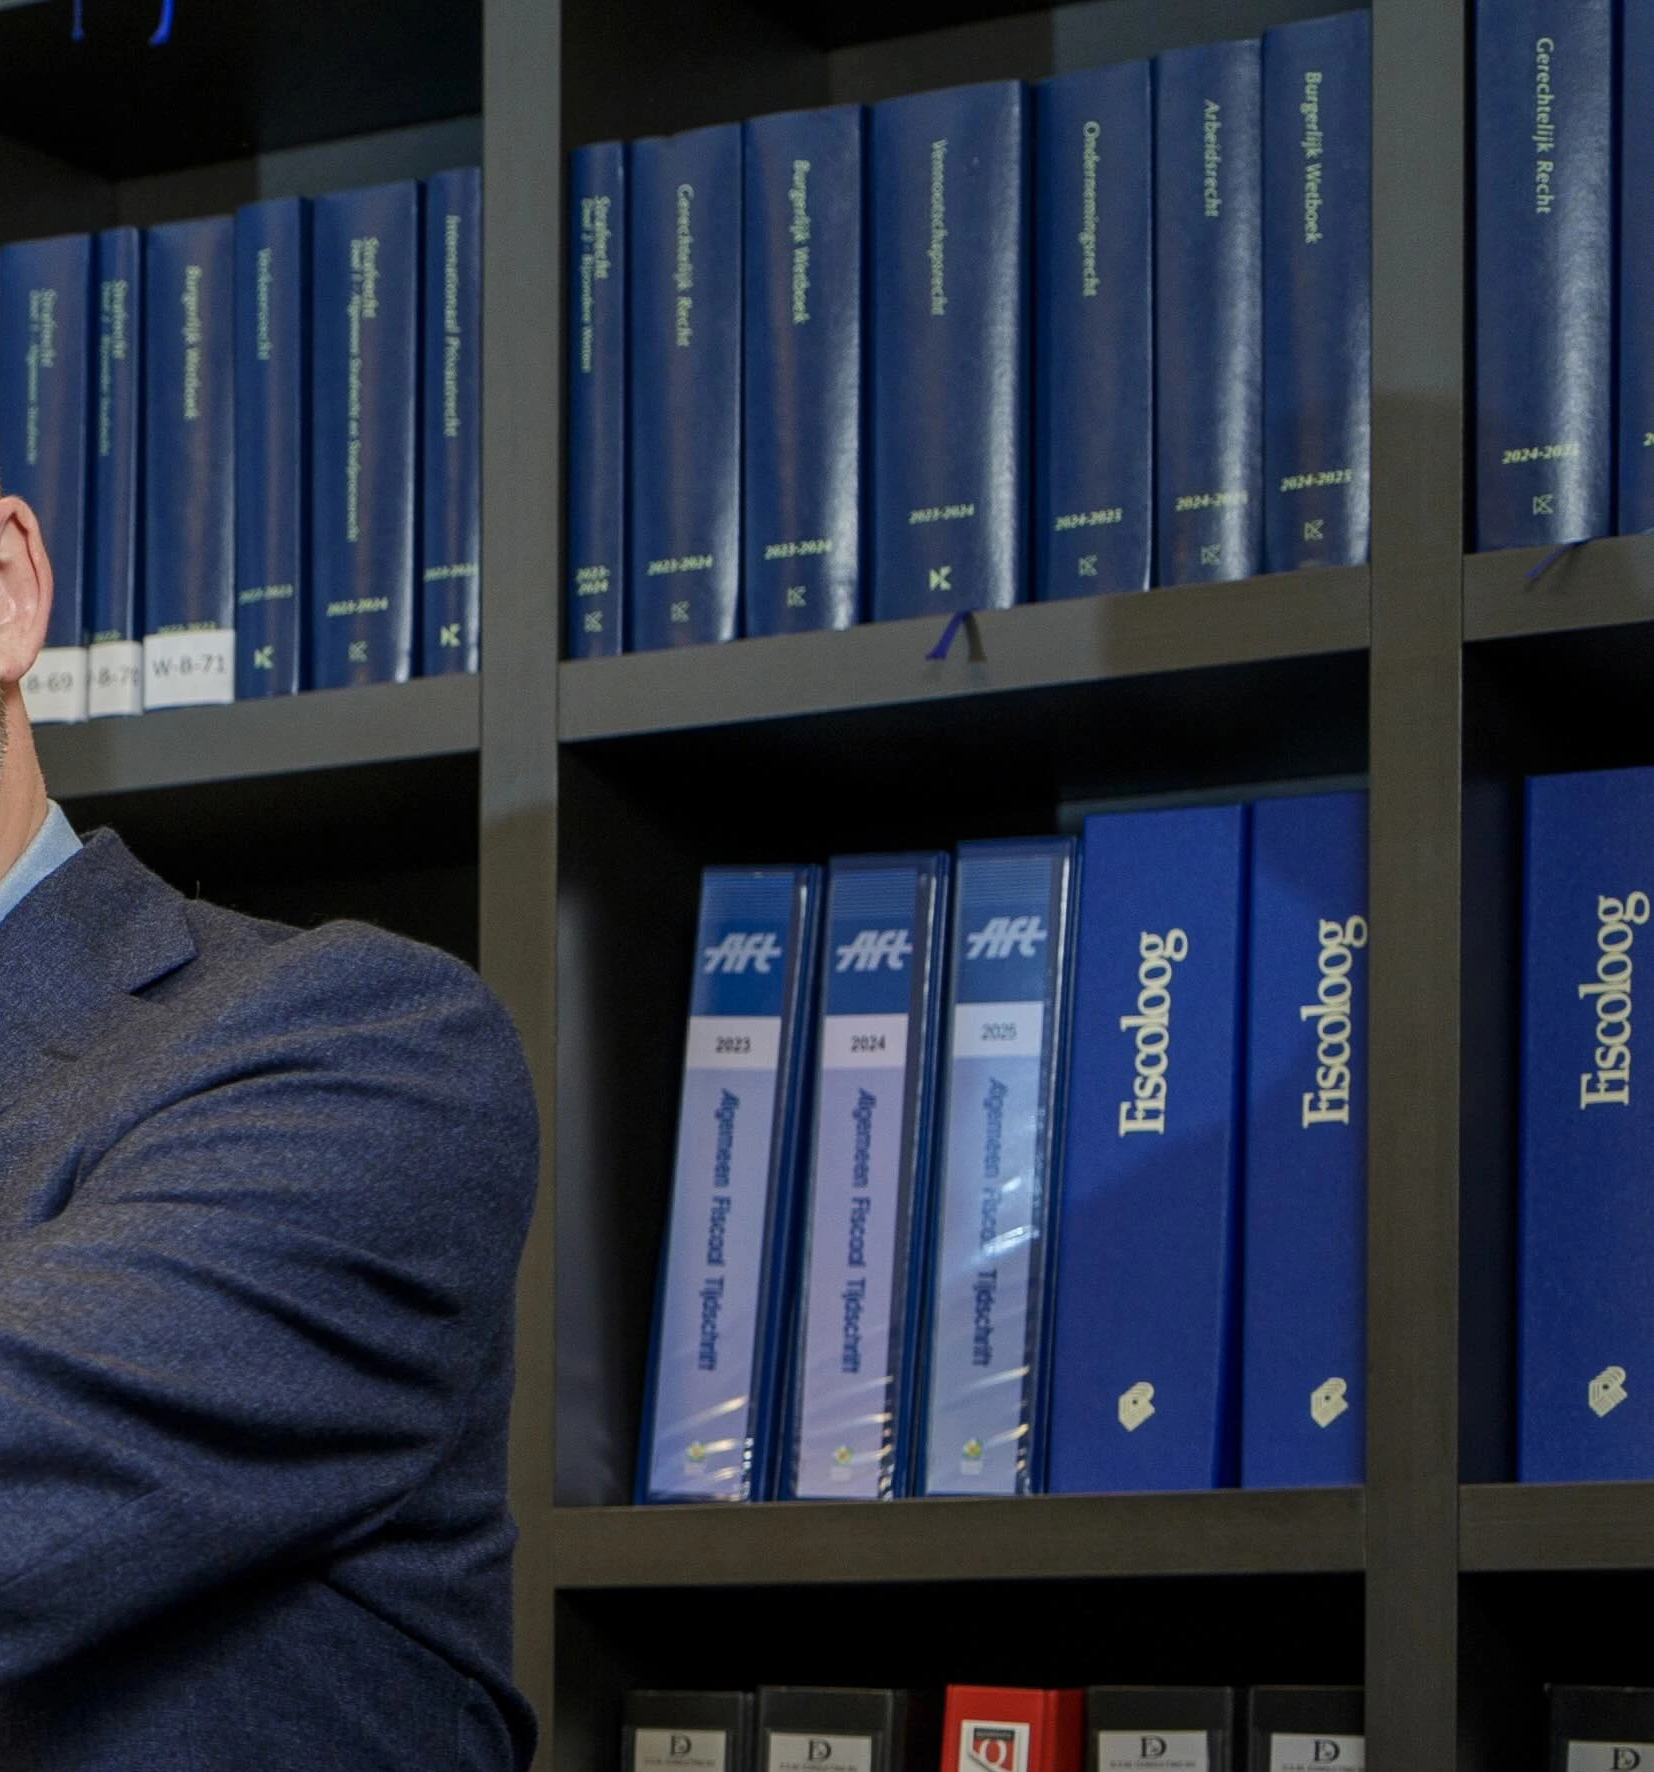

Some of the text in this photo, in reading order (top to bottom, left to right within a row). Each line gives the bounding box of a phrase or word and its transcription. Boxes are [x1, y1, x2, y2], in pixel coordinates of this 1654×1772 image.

[1077, 119, 1101, 297] Ondernemingsrecht
[1202, 98, 1221, 218] Arbeidsrecht
[1300, 70, 1323, 244] Burgerlijk Wetboek
[1532, 37, 1554, 214] Gerechtelijk Recht
[151, 653, 227, 679] W-B-71
[714, 1035, 752, 1054] 2023
[850, 1034, 887, 1053] 2024
[981, 1022, 1017, 1041] 2025
[1118, 926, 1189, 1137] Fiscoloog
[1301, 914, 1368, 1129] Fiscoloog
[1579, 890, 1651, 1111] Fiscoloog
[698, 1086, 742, 1372] Algemeen Fiscaal Tijdschrift
[840, 1086, 878, 1374] Algemeen Fiscaal Tijdschrift
[971, 1269, 999, 1368] Tijdschrift
